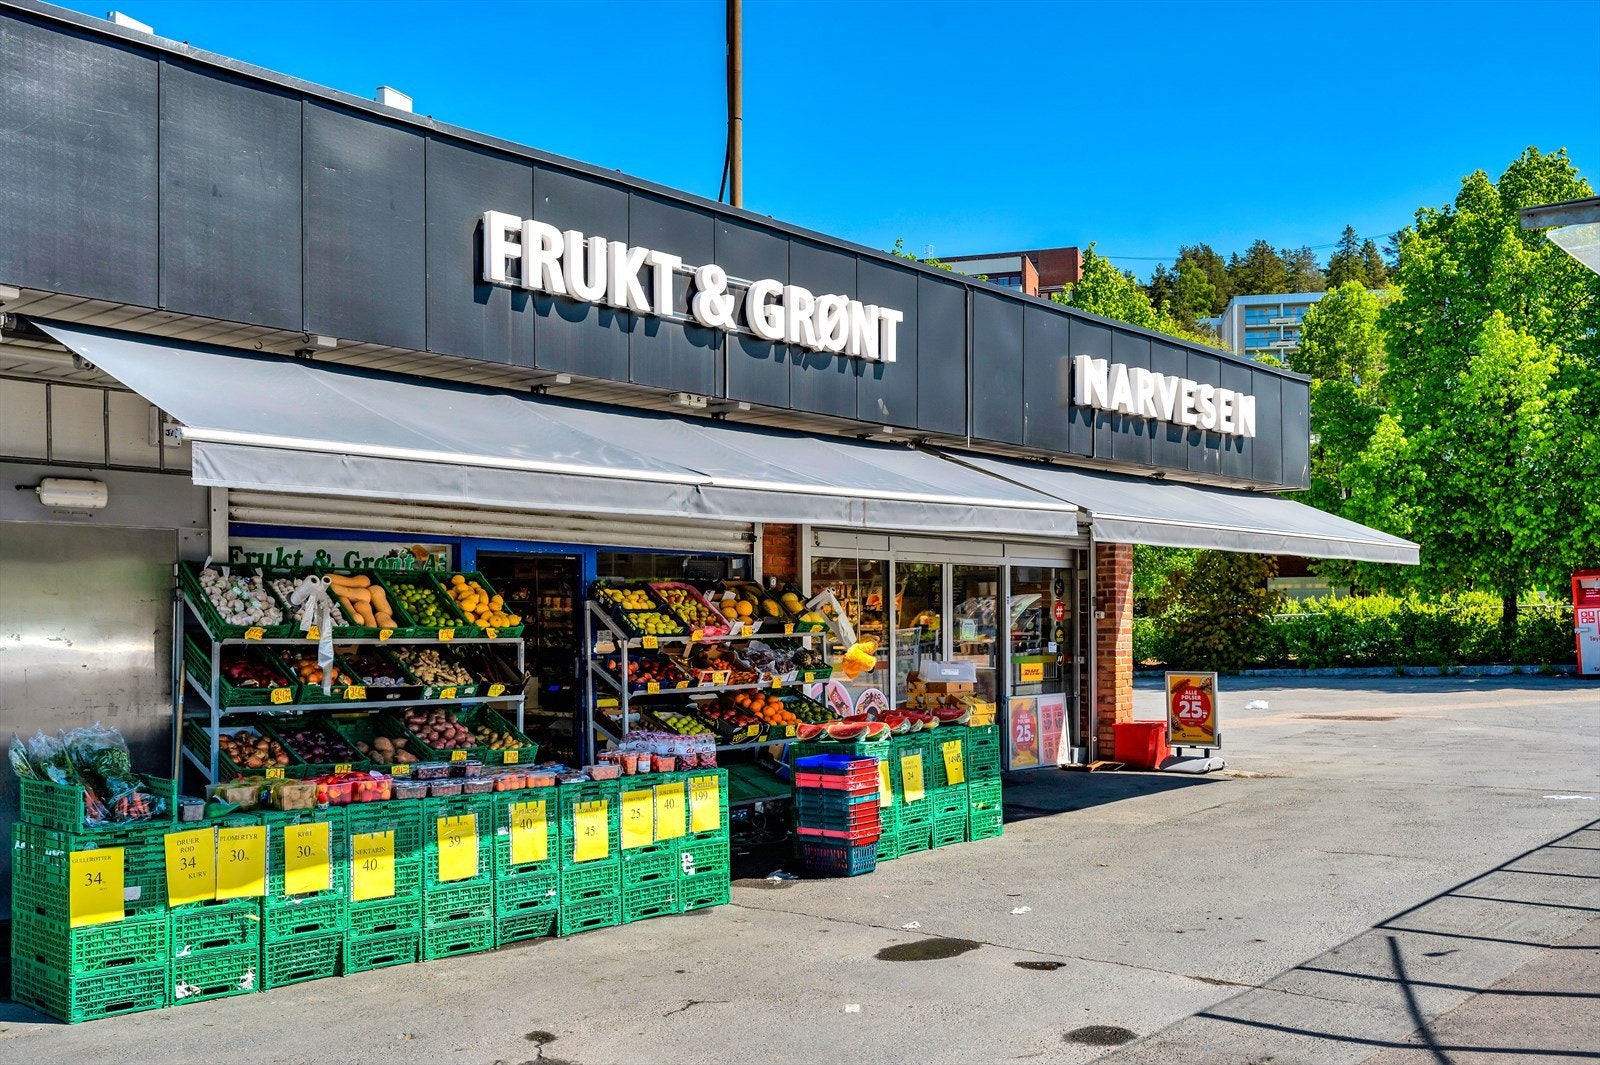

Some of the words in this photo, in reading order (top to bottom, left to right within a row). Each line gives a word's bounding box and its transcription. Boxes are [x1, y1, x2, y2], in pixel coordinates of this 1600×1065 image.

[482, 210, 682, 316] FRUKT
[693, 264, 738, 330] &
[746, 278, 903, 363] GRØNT
[1074, 354, 1256, 438] NARVESEN
[229, 545, 304, 566] Frukt
[344, 550, 415, 571] Grønt
[694, 791, 708, 801] 199
[664, 799, 675, 809] 40
[631, 809, 641, 819] 25
[520, 819, 533, 829] 40
[585, 826, 595, 836] 45
[176, 837, 200, 846] DRUER
[448, 835, 461, 848] 39
[229, 849, 245, 862] 30
[296, 845, 311, 858] 30
[355, 847, 386, 855] NEKTARIN
[180, 856, 197, 871] 34
[362, 858, 378, 871] 40
[85, 872, 102, 887] 34
[188, 871, 207, 879] KURV
